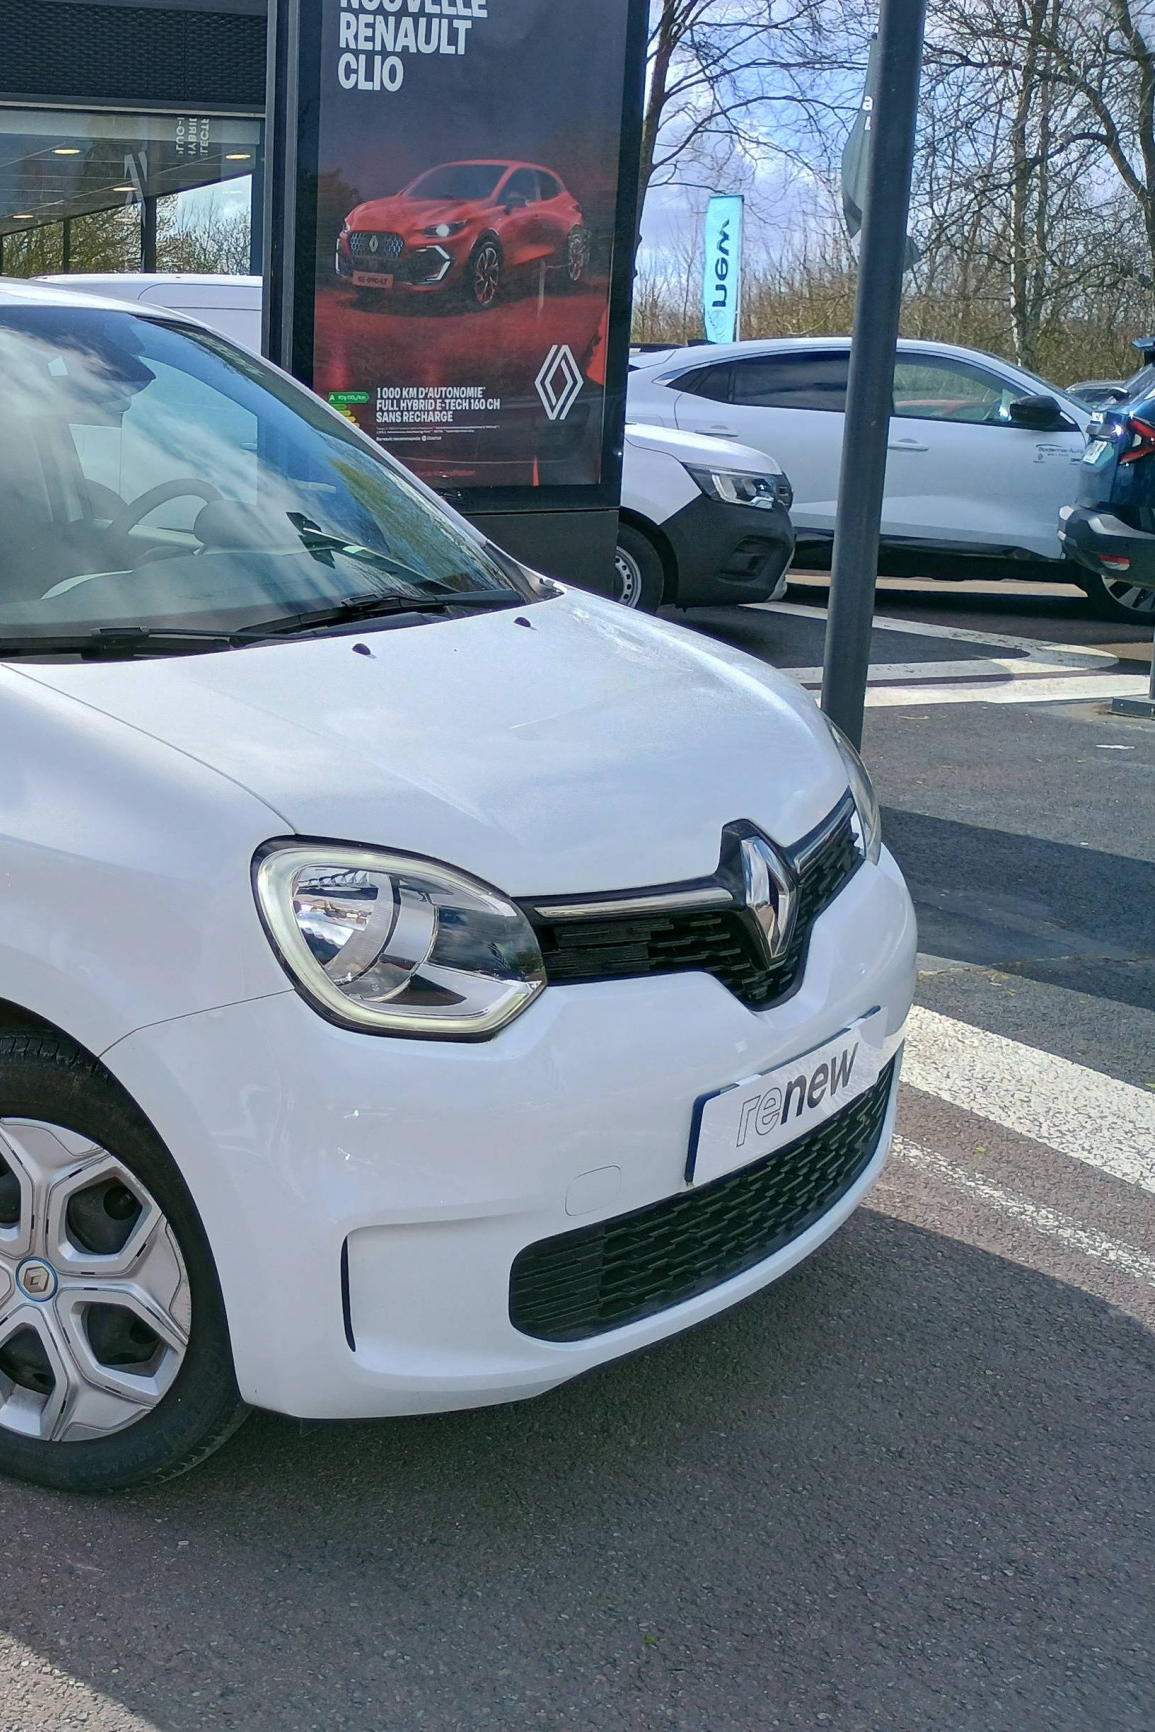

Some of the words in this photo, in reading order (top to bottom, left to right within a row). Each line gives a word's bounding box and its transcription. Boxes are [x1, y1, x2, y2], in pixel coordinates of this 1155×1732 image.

[339, 12, 472, 55] RENAULT
[338, 52, 404, 92] CLIO
[376, 399, 399, 411] FULL
[400, 399, 435, 410] HYBRID
[436, 399, 469, 410] E-TECH
[470, 398, 485, 410] 160
[487, 398, 501, 410] CH
[402, 387, 417, 398] KM
[376, 411, 401, 423] SANS
[403, 411, 454, 423] RECHARGE
[736, 1041, 859, 1148] renew
